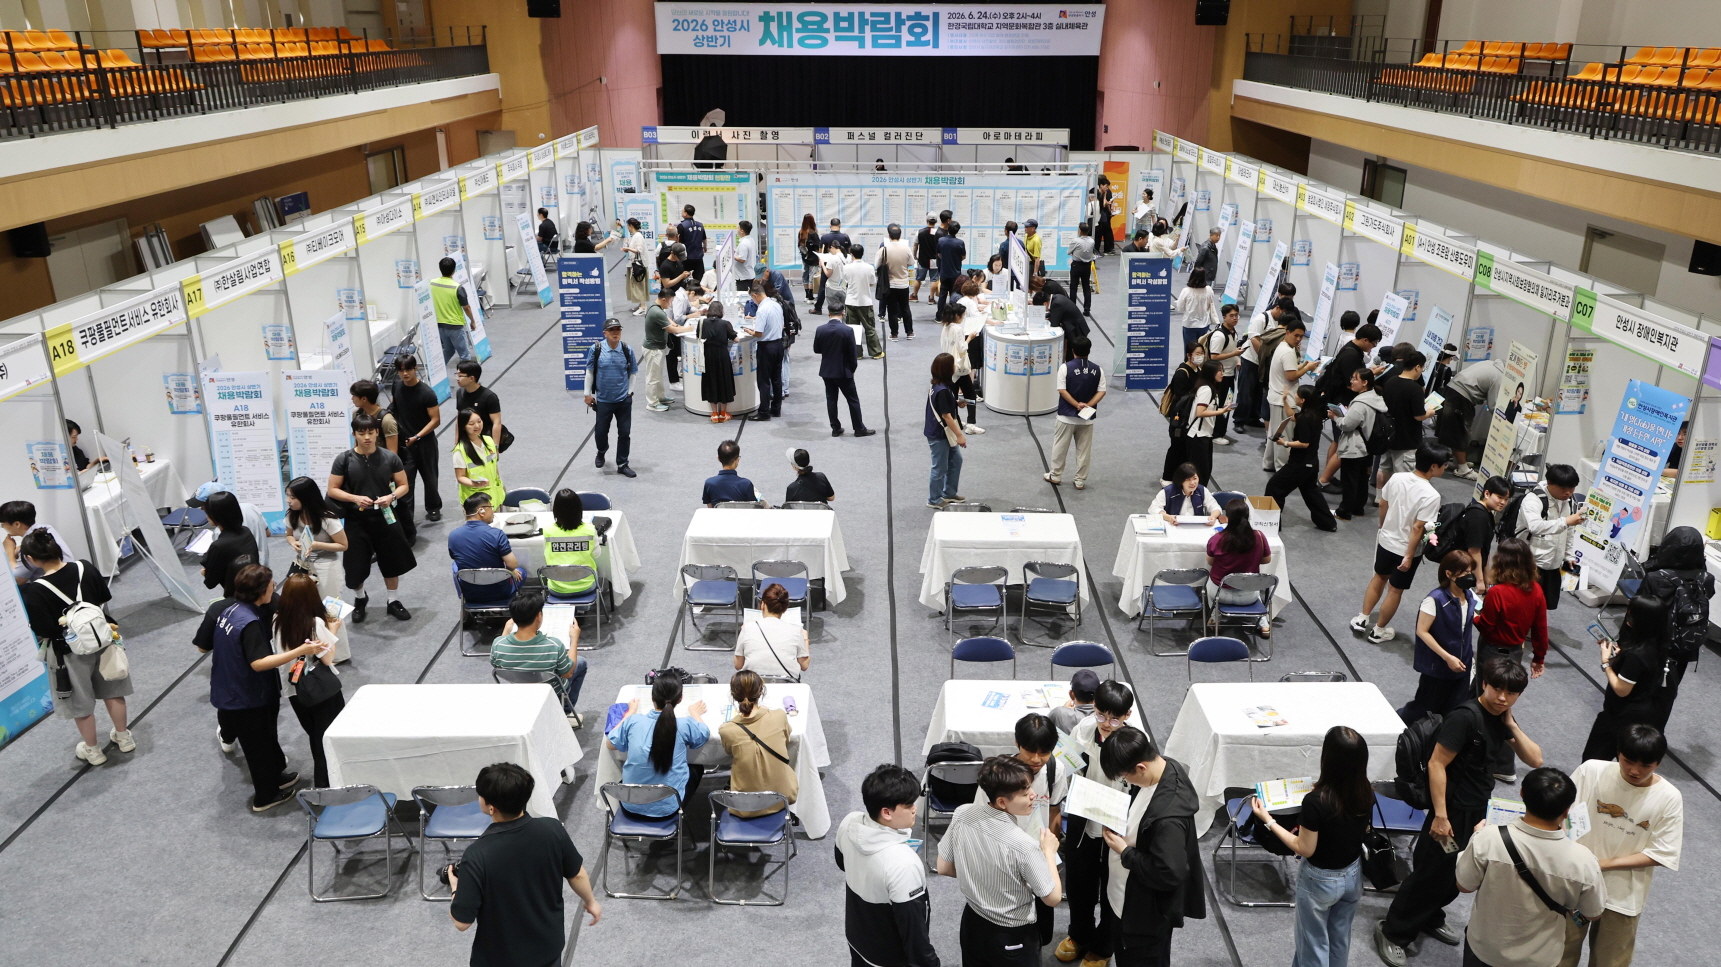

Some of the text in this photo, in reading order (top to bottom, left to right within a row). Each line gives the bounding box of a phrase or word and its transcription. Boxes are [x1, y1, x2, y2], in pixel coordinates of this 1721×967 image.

[672, 19, 750, 32] 2026 안성시
[758, 11, 940, 49] 채용박람회
[693, 35, 731, 48] 상반기
[732, 130, 751, 140] 사진
[760, 130, 780, 140] 촬영
[847, 132, 924, 140] 퍼스널 컬러진단
[983, 132, 1043, 140] 아로마테라피
[925, 177, 965, 185] 채용박람회
[1346, 211, 1354, 221] A02
[356, 223, 366, 235] A15
[1405, 234, 1414, 246] A01
[282, 251, 295, 266] A16
[1427, 240, 1436, 254] 안성
[1450, 249, 1473, 269] 산후도우미
[1478, 263, 1492, 278] C08
[1494, 268, 1540, 296] 안성시지역사회보장협의체
[187, 288, 202, 305] A17
[1576, 302, 1594, 318] C07
[79, 294, 179, 348] 쿠팡풀필먼트서비스 유한회사
[1616, 315, 1678, 352] 안성시 장애인복지관
[52, 340, 74, 361] A18
[1074, 368, 1097, 376] 안성시
[218, 389, 262, 400] 채용박람회
[294, 389, 339, 397] 채용박람회
[1638, 403, 1677, 422] 안성시장애인복지관
[552, 542, 589, 552] 안전관리팀
